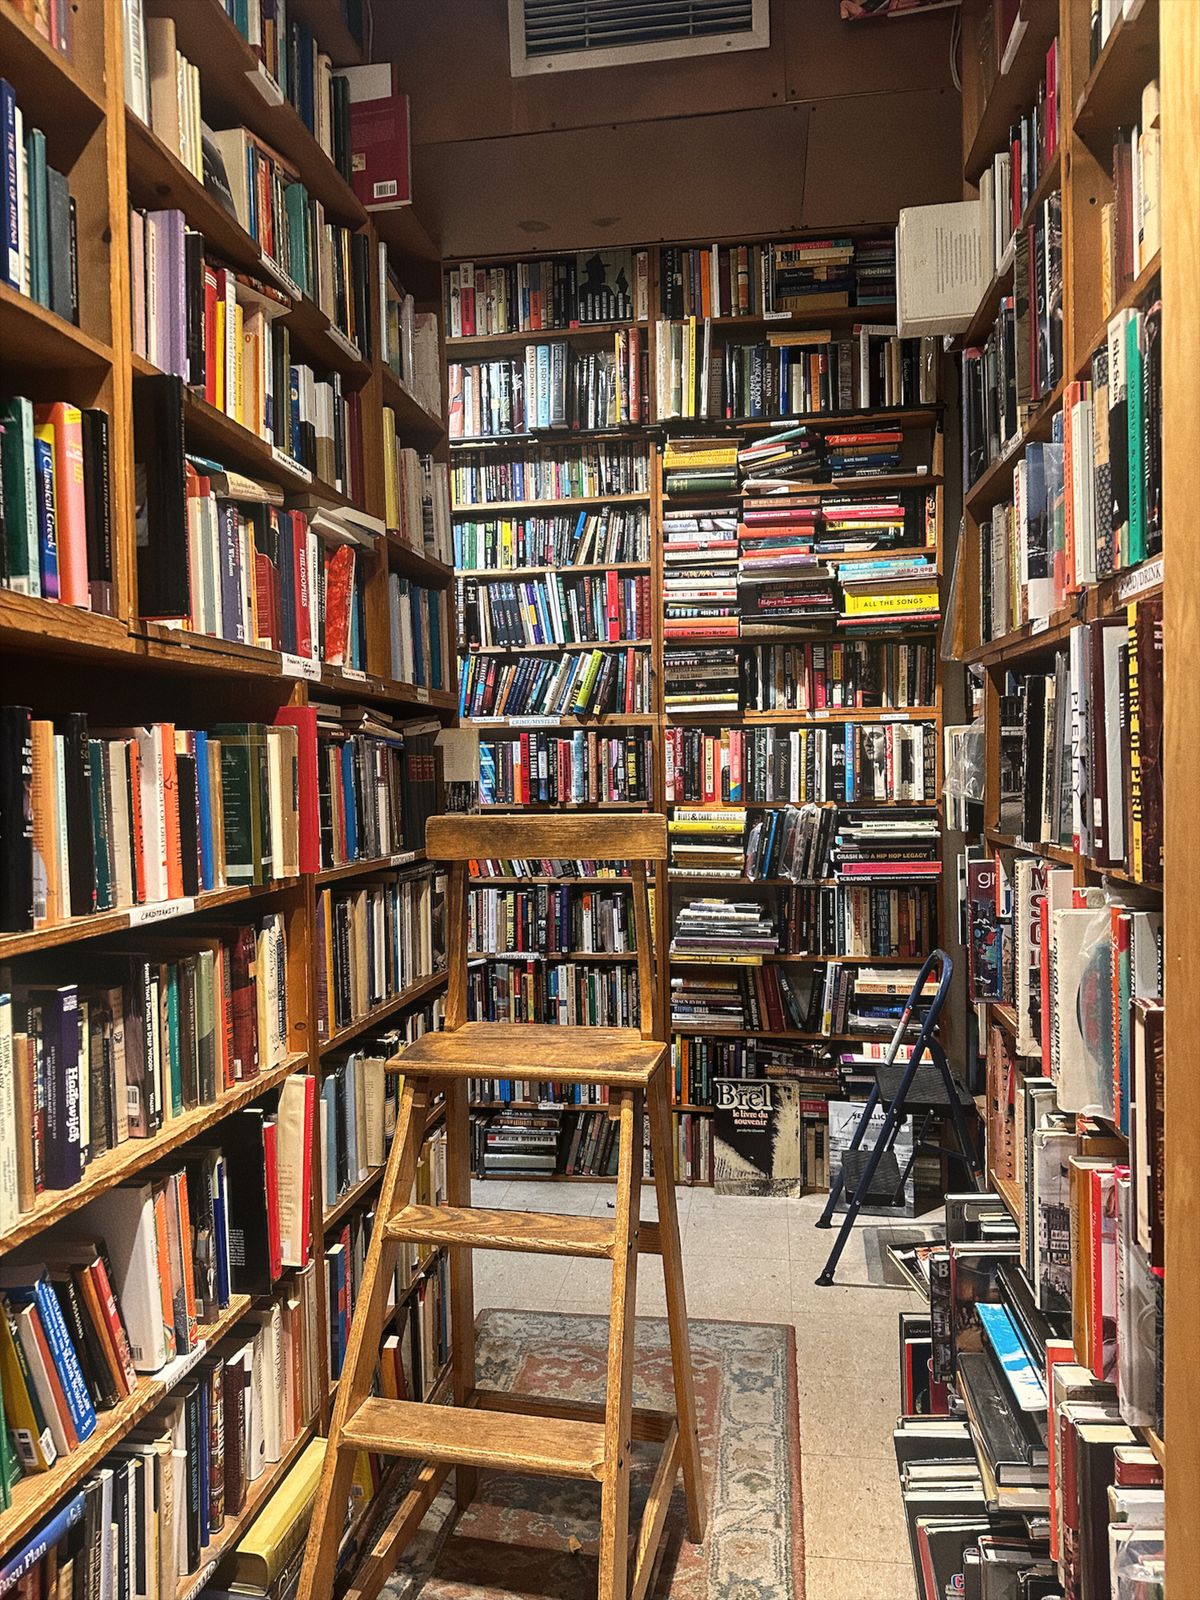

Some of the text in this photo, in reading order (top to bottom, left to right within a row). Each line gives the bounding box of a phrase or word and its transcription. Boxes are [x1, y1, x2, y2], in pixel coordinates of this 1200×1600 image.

[9, 186, 15, 200] OF
[1112, 339, 1120, 367] Six
[1130, 371, 1138, 441] COCONUT
[42, 456, 55, 548] Classical Greek
[1130, 462, 1138, 526] SAMBAL
[227, 537, 234, 545] of
[299, 549, 307, 607] PHILOSOPHIES
[897, 598, 923, 606] SONGS
[1153, 620, 1163, 650] THE
[1128, 628, 1141, 822] THE FIRE OF PERU
[157, 754, 162, 764] IN
[529, 734, 537, 756] DENNIS
[759, 737, 767, 755] Myself
[1071, 692, 1080, 798] PLENTY
[159, 809, 164, 822] OF
[678, 813, 690, 821] BLUES
[3, 1034, 11, 1077] STRONG'S
[65, 1066, 80, 1143] Hadewijch
[716, 1083, 773, 1110] Brel
[740, 1110, 757, 1118] livre
[65, 1282, 90, 1339] THE ASSASSINS
[59, 1349, 78, 1380] MAJOR
[67, 1355, 94, 1411] ISLAMIC LAW
[68, 1380, 89, 1418] SCHOOLS
[79, 1420, 96, 1434] ABC
[191, 1437, 196, 1449] OF
[24, 1542, 47, 1569] Plan
